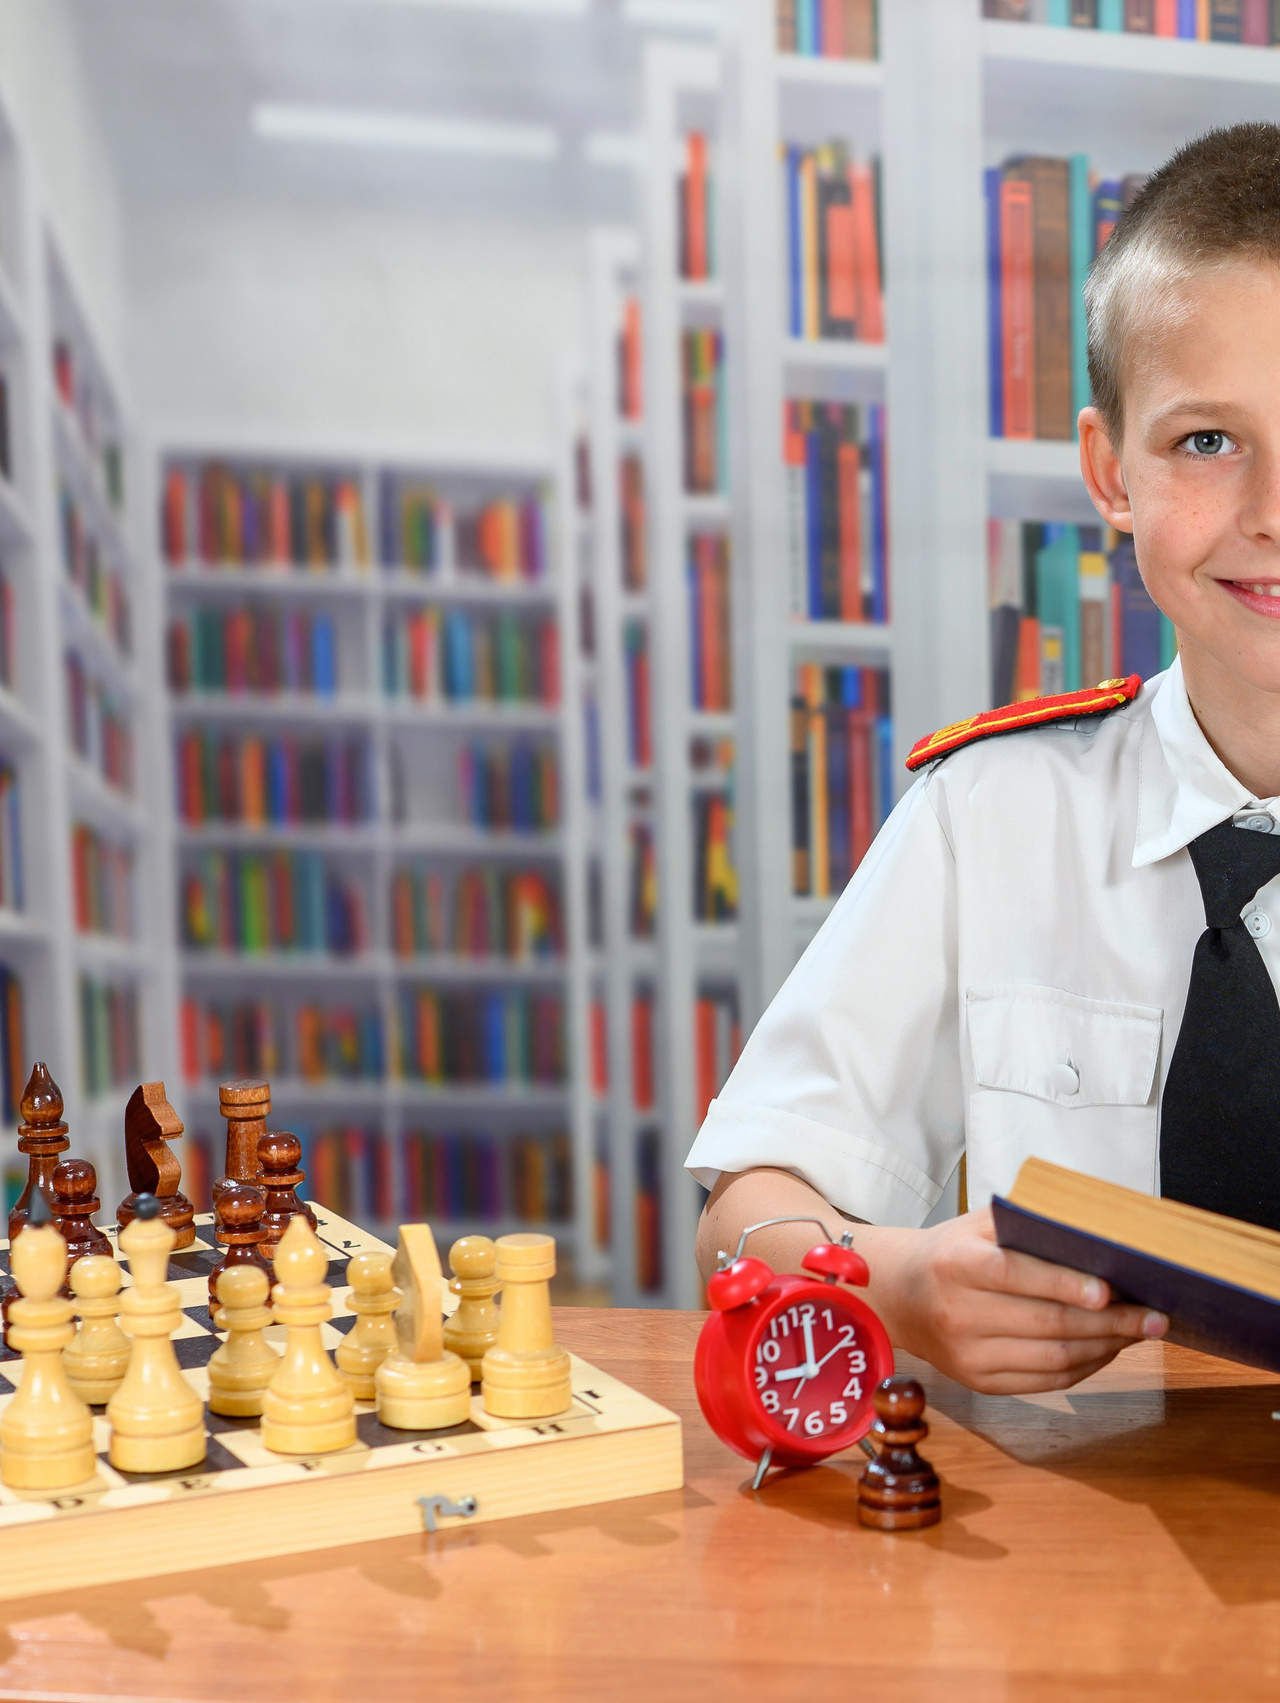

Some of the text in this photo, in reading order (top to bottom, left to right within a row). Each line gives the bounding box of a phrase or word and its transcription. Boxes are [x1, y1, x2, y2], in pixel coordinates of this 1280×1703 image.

[770, 1315, 789, 1338] 11
[787, 1303, 817, 1328] 12
[821, 1309, 834, 1331] 1
[838, 1325, 857, 1348] 2
[756, 1340, 781, 1364] 10
[847, 1350, 867, 1373] 3
[842, 1377, 863, 1400] 4
[760, 1390, 780, 1414] 8
[830, 1401, 848, 1424] 5
[530, 1423, 566, 1435] H
[782, 1407, 800, 1431] 7
[804, 1410, 824, 1435] 6
[412, 1441, 443, 1455] G
[297, 1460, 322, 1473] F
[178, 1478, 210, 1491] E
[50, 1496, 84, 1510] D
